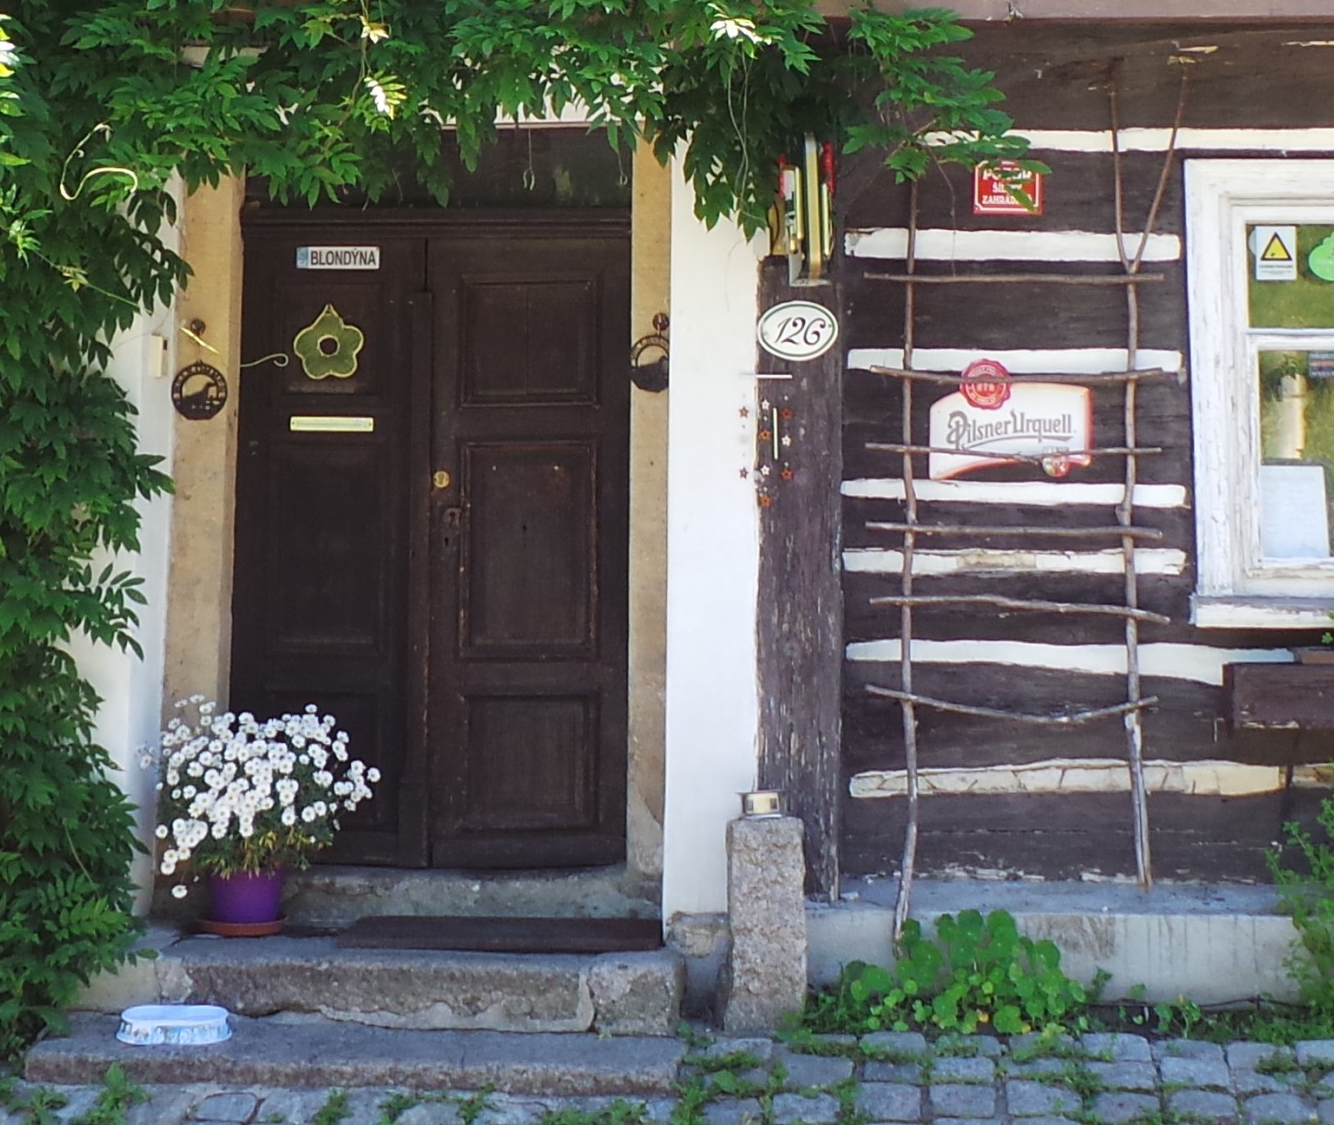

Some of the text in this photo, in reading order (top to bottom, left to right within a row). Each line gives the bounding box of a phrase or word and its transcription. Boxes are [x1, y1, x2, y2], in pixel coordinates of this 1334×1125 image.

[311, 247, 376, 266] BLONDÝNA
[775, 316, 826, 345] 126
[946, 409, 1073, 451] Pilsner Urquell
